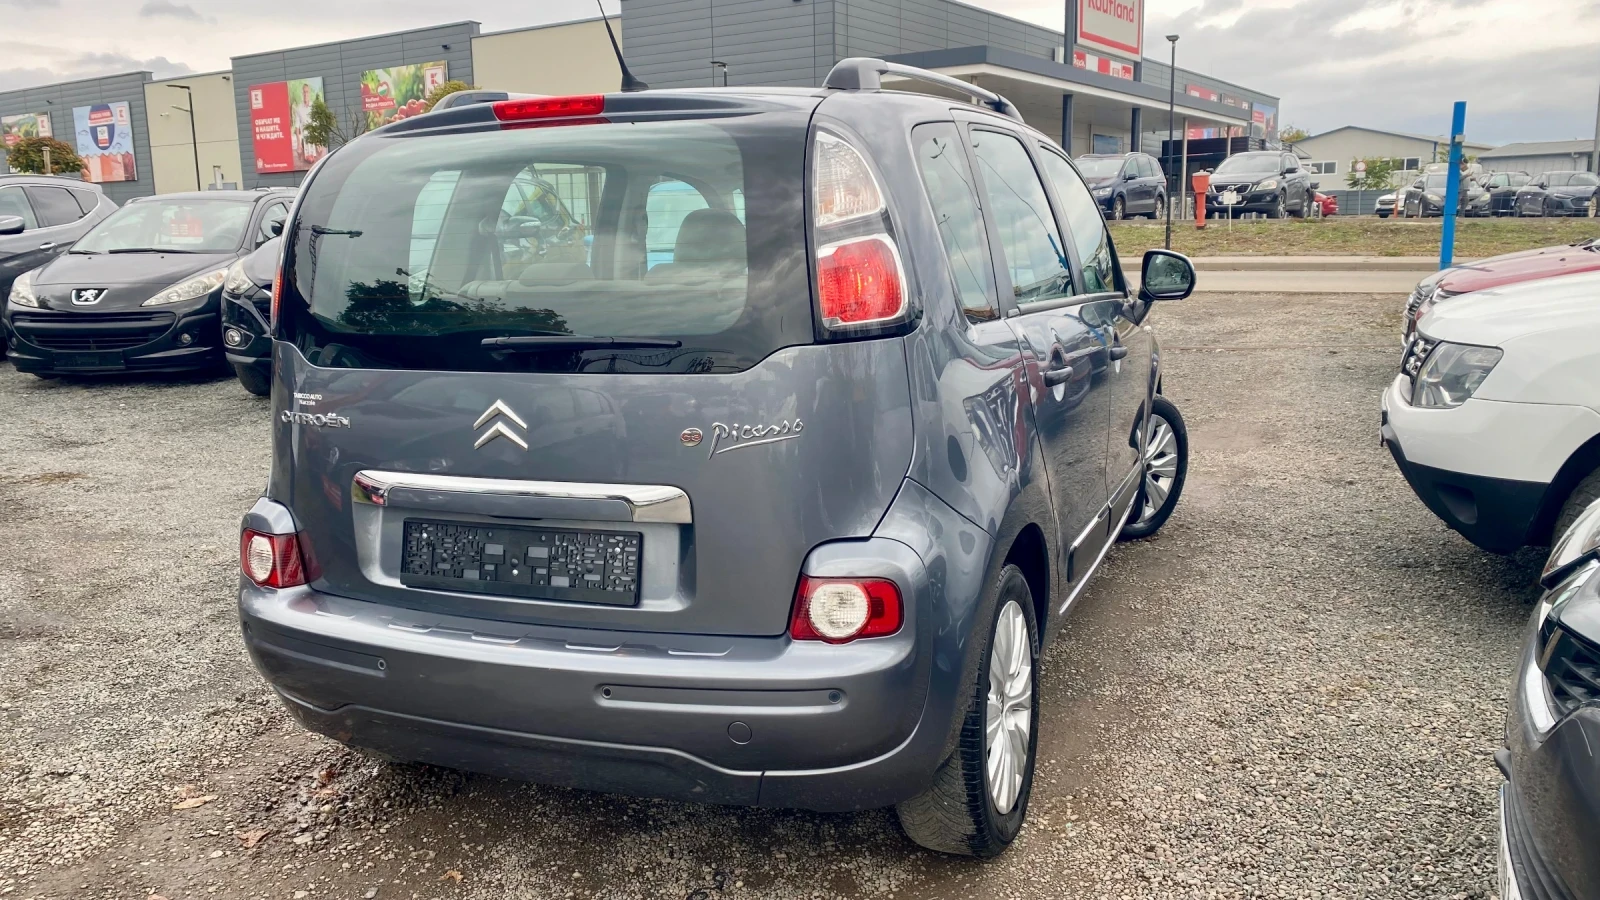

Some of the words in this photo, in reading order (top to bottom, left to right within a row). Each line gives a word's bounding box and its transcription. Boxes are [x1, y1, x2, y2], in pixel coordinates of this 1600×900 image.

[255, 118, 272, 126] ОБИЧАТ
[260, 125, 281, 133] НАШИТЕ,
[260, 132, 285, 140] ЧУЖДИТЕ.
[708, 418, 804, 460] Picasso
